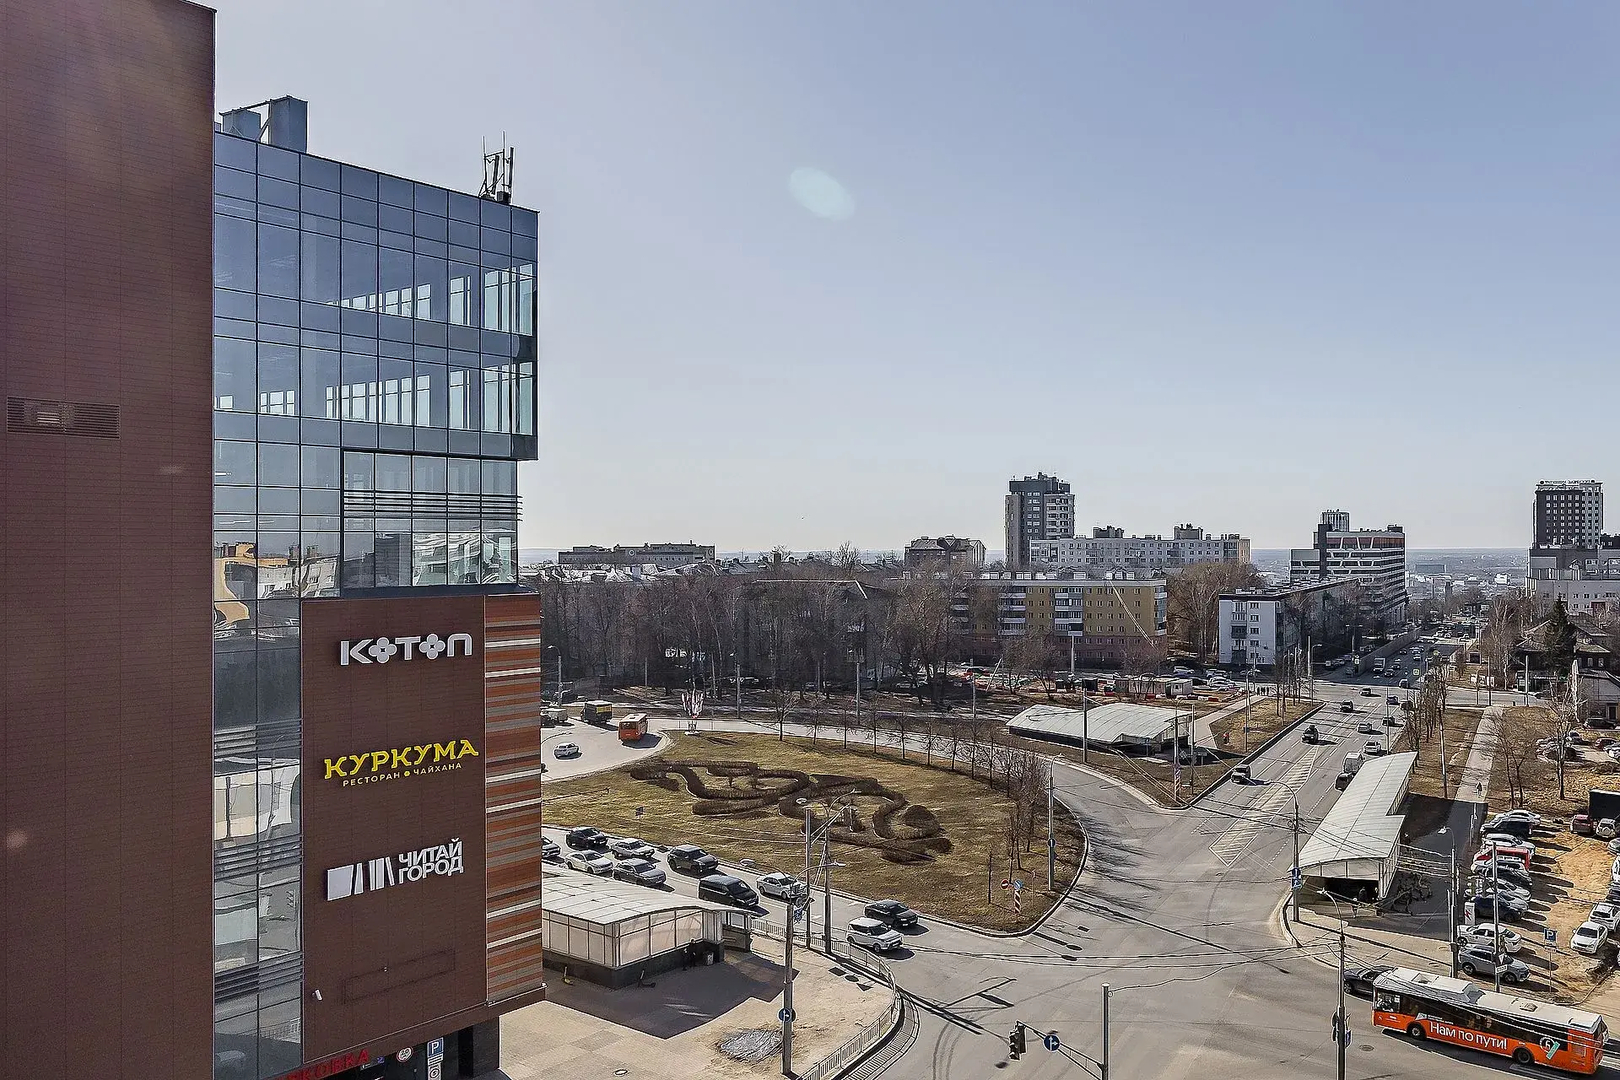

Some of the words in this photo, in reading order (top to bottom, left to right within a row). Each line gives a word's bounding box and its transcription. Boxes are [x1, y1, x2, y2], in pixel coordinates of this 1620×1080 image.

[324, 739, 479, 779] КУРКУМА
[342, 771, 401, 787] РЕСТОРАН
[413, 762, 462, 776] ЧАЙХАНА
[398, 837, 463, 868] ЧИТАЙ
[398, 855, 464, 885] ГОРОД
[431, 1041, 440, 1054] P
[1429, 1021, 1456, 1038] Нам
[1458, 1030, 1474, 1042] по
[1475, 1034, 1508, 1050] пути!
